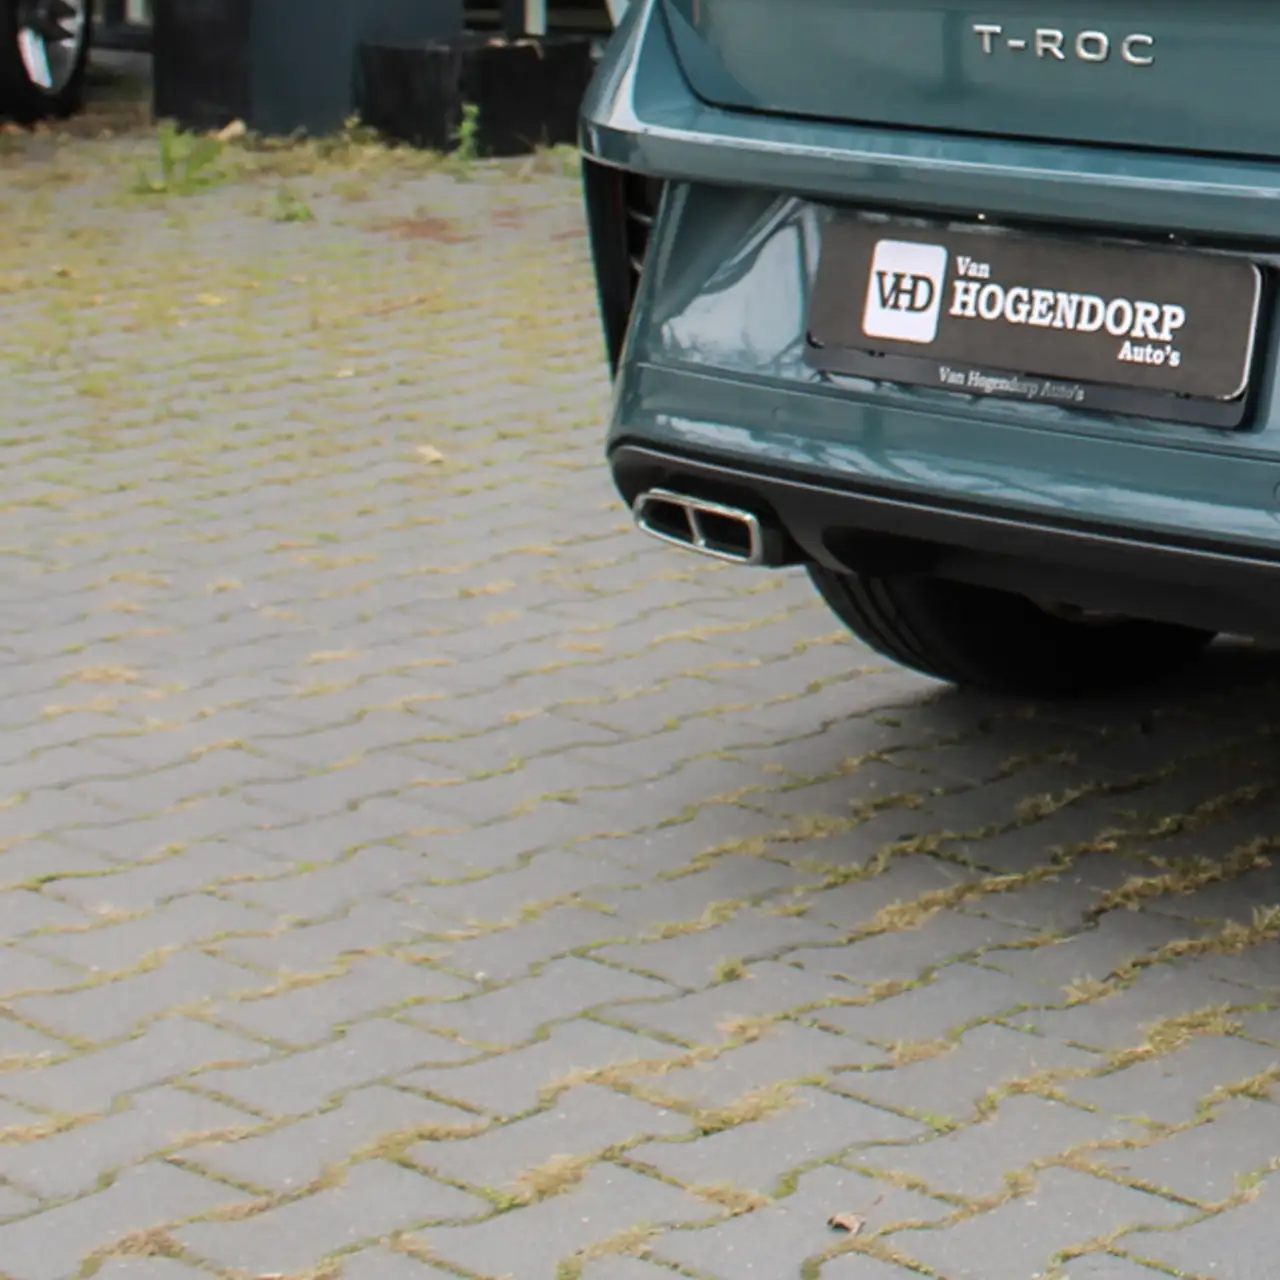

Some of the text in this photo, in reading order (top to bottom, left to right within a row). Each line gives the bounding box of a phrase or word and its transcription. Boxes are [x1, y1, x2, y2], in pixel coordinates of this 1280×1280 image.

[973, 24, 1154, 65] T-ROC
[956, 255, 990, 279] Van
[949, 279, 1185, 342] HOGENDORP
[1118, 340, 1180, 367] Auto's
[939, 366, 966, 385] Van
[967, 370, 1039, 399] Hogendorp
